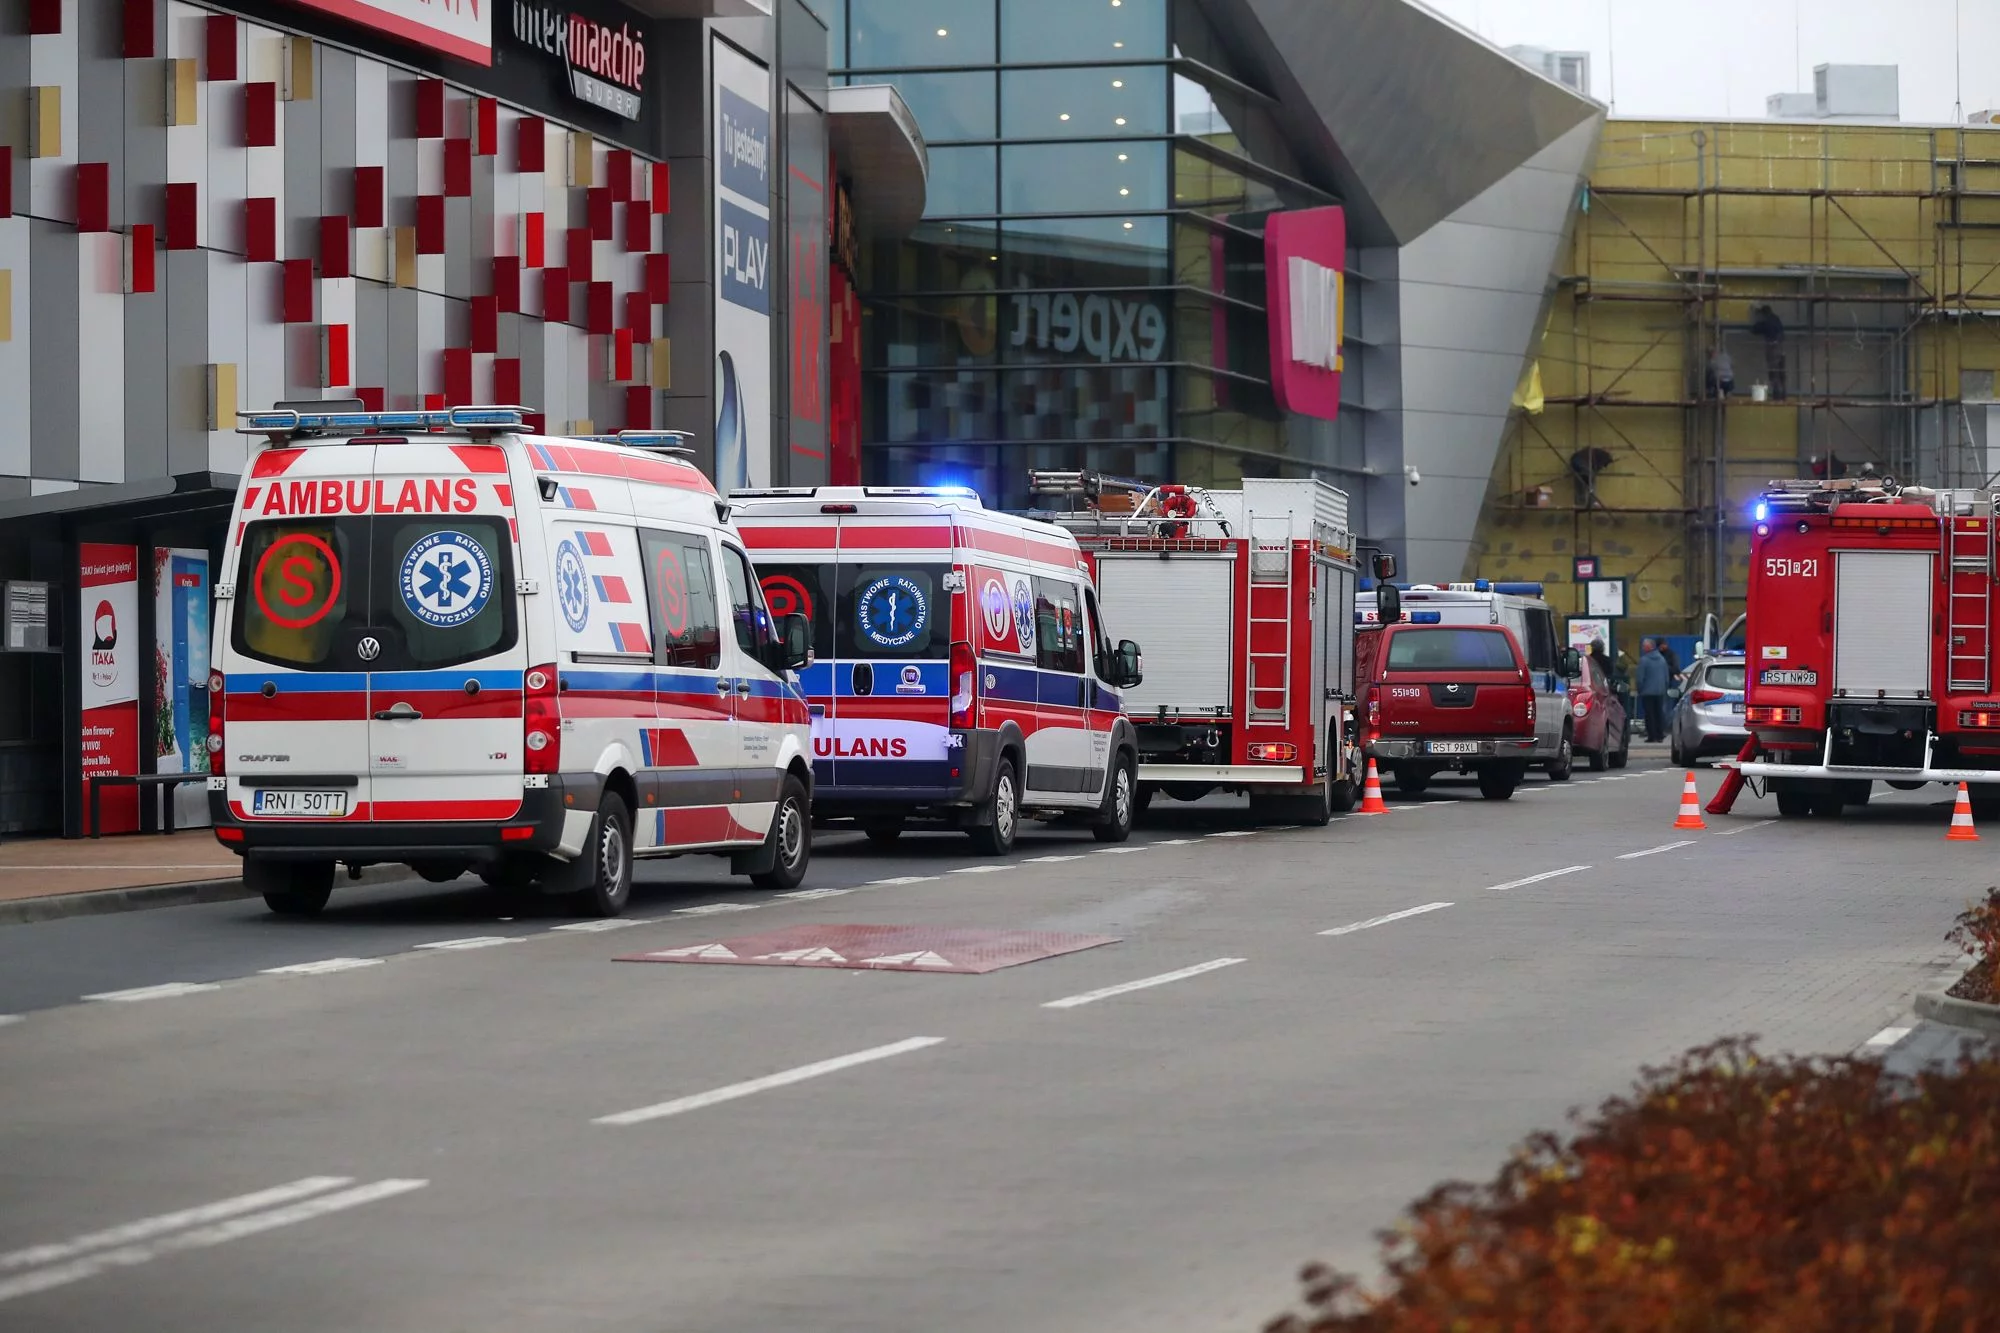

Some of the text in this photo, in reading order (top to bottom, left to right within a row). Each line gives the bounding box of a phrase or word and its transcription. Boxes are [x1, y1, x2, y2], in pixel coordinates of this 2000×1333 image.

[723, 113, 767, 182] Tu jesteśmy!
[724, 224, 768, 290] PLAY
[262, 479, 478, 516] AMBULANS
[403, 536, 441, 599] PAŃSTWOWE
[455, 535, 491, 599] RATOWNICTWO
[280, 556, 314, 607] S
[859, 578, 926, 630] PAŃSTWOWE RATOWNICTWO
[417, 606, 476, 623] MEDYCZNE
[870, 631, 915, 646] MEDYCZNE
[92, 652, 115, 666] ITAKA
[1766, 672, 1815, 683] RST NW98
[813, 737, 908, 758] ULANS
[1433, 743, 1478, 752] RST 98XL
[239, 754, 291, 762] CRAFTER
[265, 793, 343, 810] RNI 50TT
